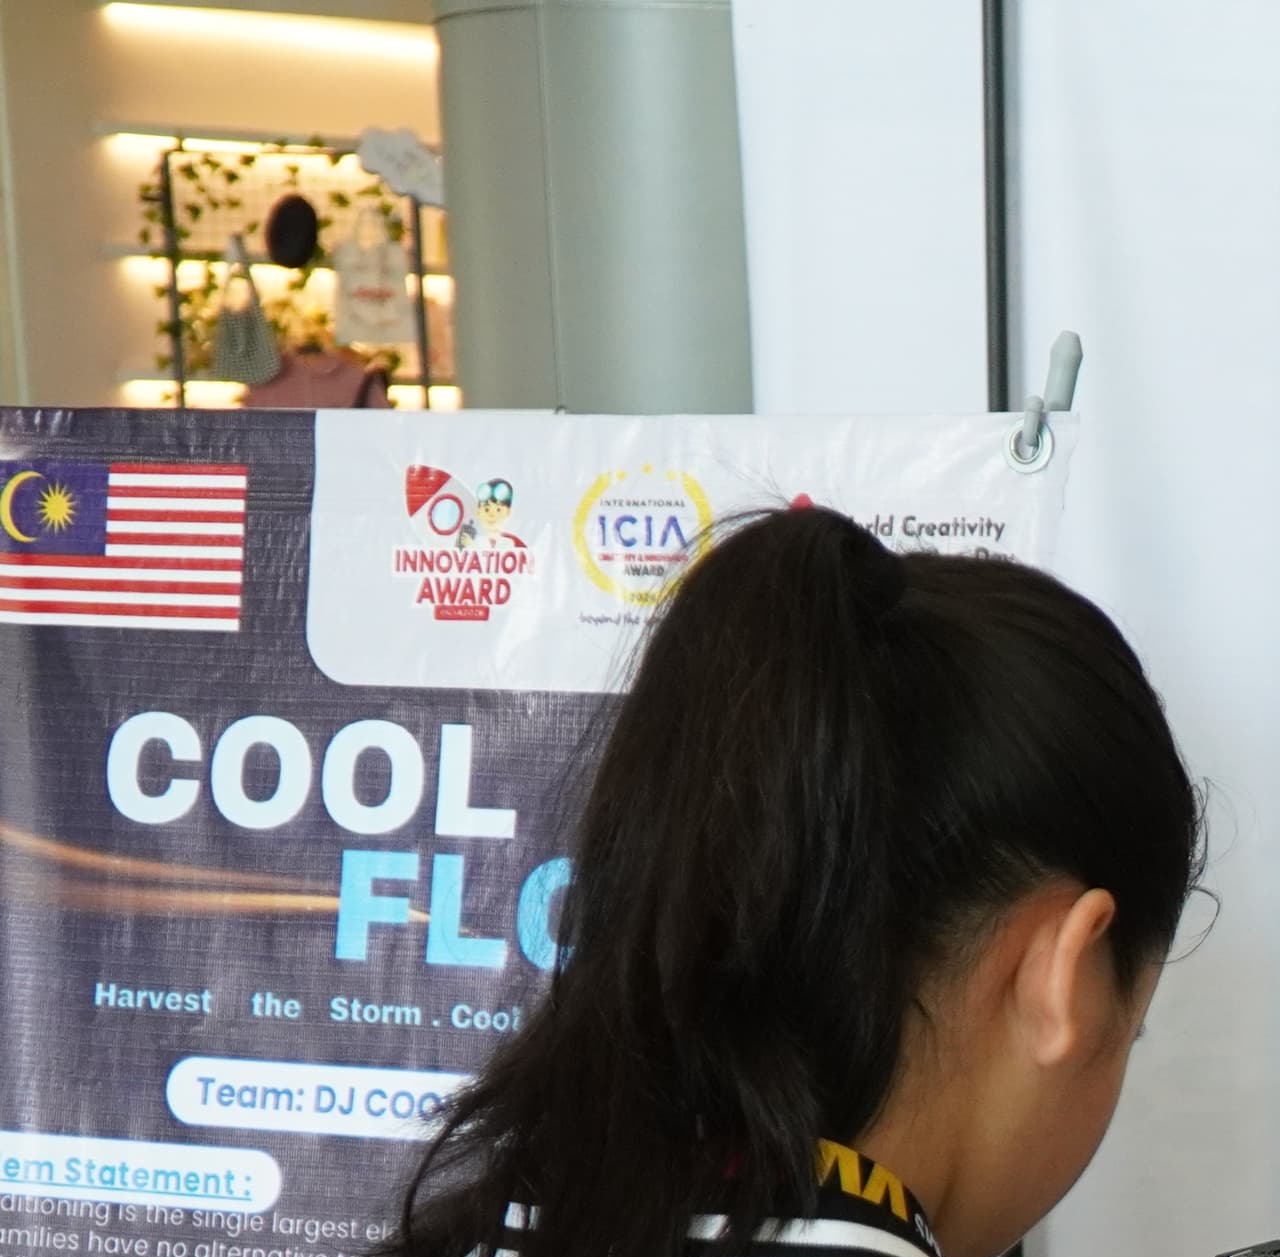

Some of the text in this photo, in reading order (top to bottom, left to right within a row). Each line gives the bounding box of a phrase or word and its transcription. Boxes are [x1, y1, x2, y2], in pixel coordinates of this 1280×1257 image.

[600, 499, 685, 507] INTERNATIONAL
[902, 515, 1005, 541] Creativity
[395, 549, 533, 575] INNOVATION
[624, 564, 664, 576] AWARD
[416, 577, 511, 604] AWARD
[107, 710, 516, 838] COOL
[336, 849, 575, 970] FLO
[95, 982, 212, 1014] Harvest
[252, 992, 300, 1018] the
[330, 996, 420, 1025] Storm
[197, 1076, 304, 1111] Team:
[314, 1085, 355, 1115] DJ
[65, 1157, 235, 1195] Statement
[119, 1202, 137, 1222] is
[146, 1204, 184, 1225] the
[193, 1208, 264, 1238] single
[272, 1211, 357, 1243] largest
[0, 1225, 79, 1250] milies
[88, 1230, 148, 1256] have
